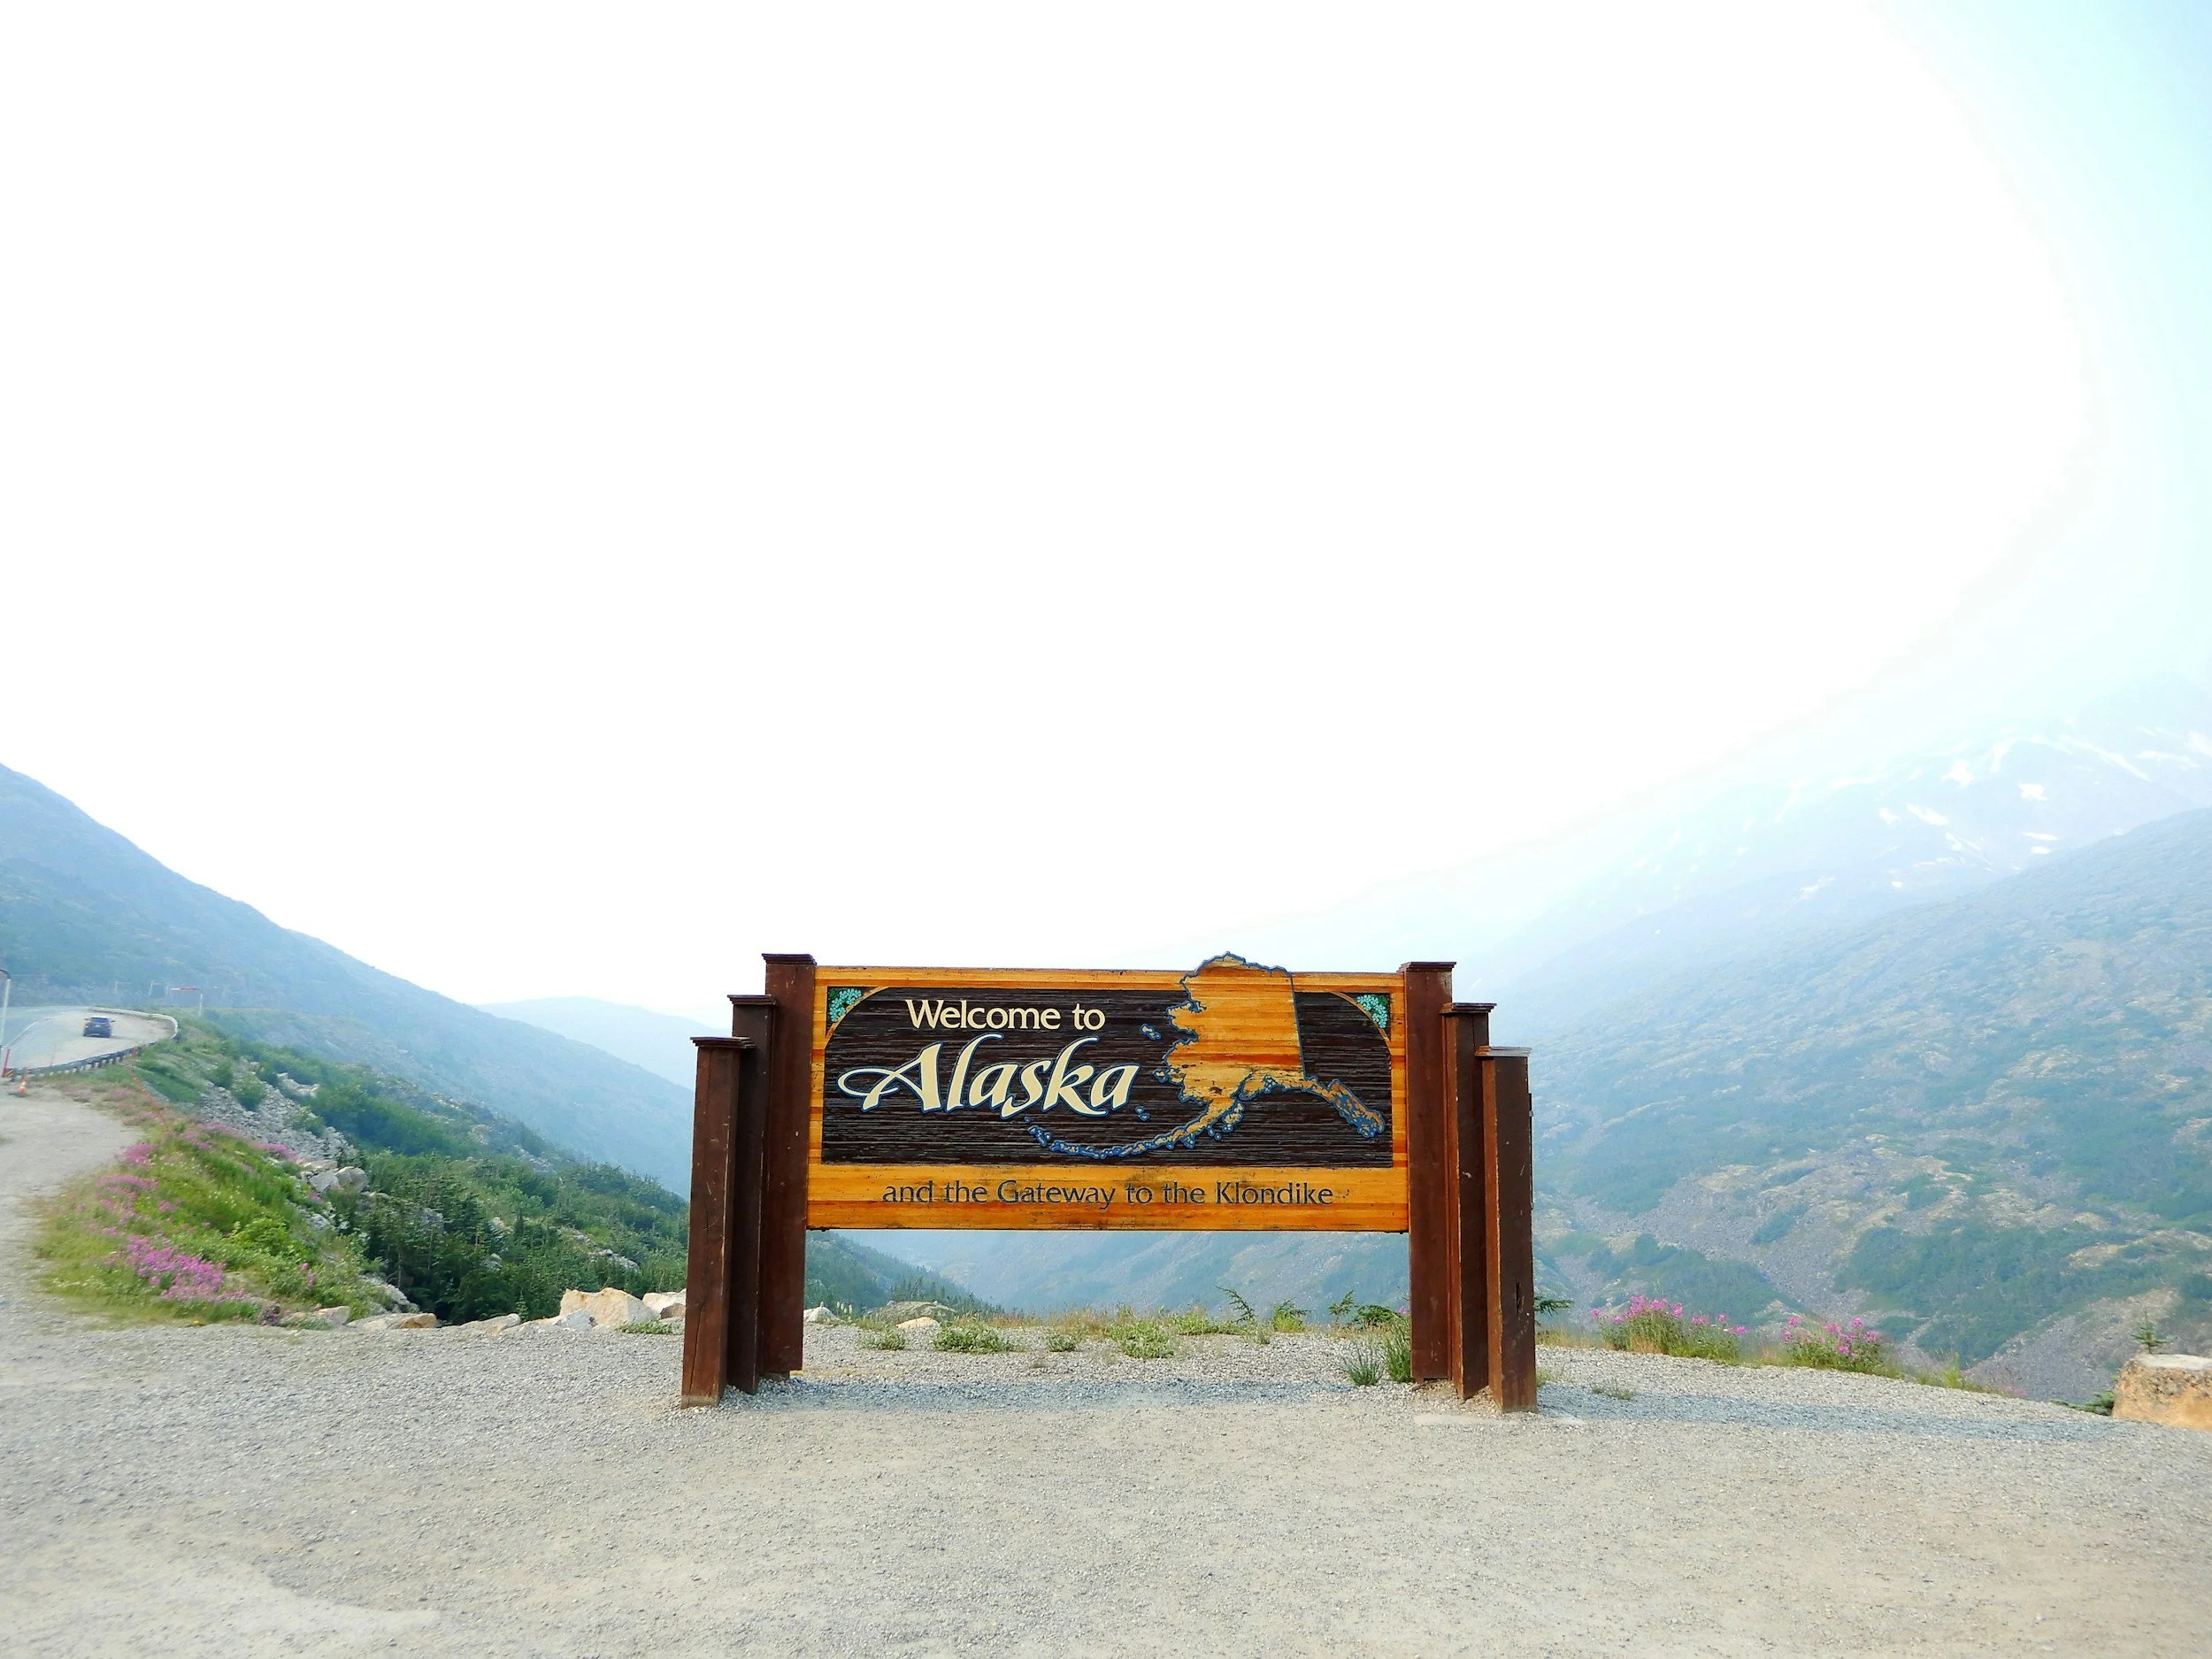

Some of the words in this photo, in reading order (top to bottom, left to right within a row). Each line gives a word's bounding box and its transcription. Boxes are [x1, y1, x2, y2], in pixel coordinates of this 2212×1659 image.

[905, 999, 1061, 1031] Welcome
[1071, 1002, 1106, 1031] to
[837, 1033, 1141, 1119] Alaska
[883, 1179, 933, 1204] and
[943, 1179, 988, 1204] the
[997, 1179, 1116, 1210] Gateway
[1125, 1182, 1153, 1205] to
[1163, 1181, 1205, 1205] the
[1215, 1181, 1334, 1205] Klondike
